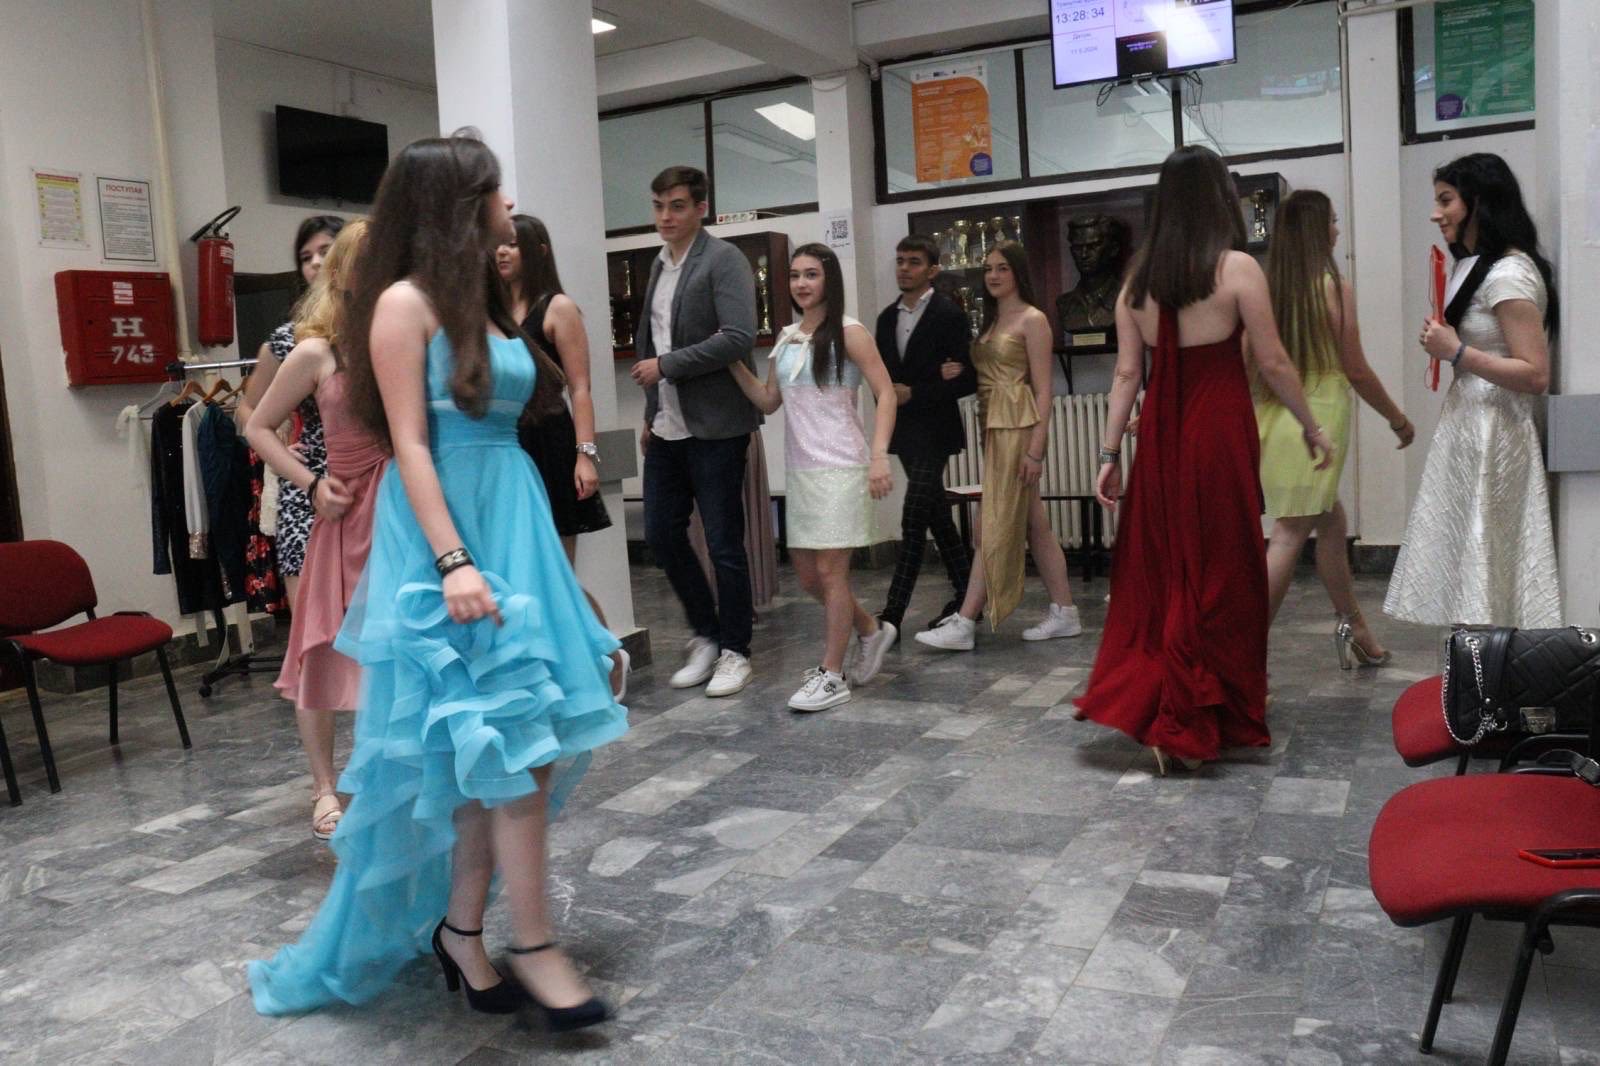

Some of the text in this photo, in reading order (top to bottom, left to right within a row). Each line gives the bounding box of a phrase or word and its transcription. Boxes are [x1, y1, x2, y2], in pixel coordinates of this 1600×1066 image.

[1056, 7, 1104, 24] 13:28:34
[111, 317, 145, 337] H
[111, 344, 154, 364] 743
